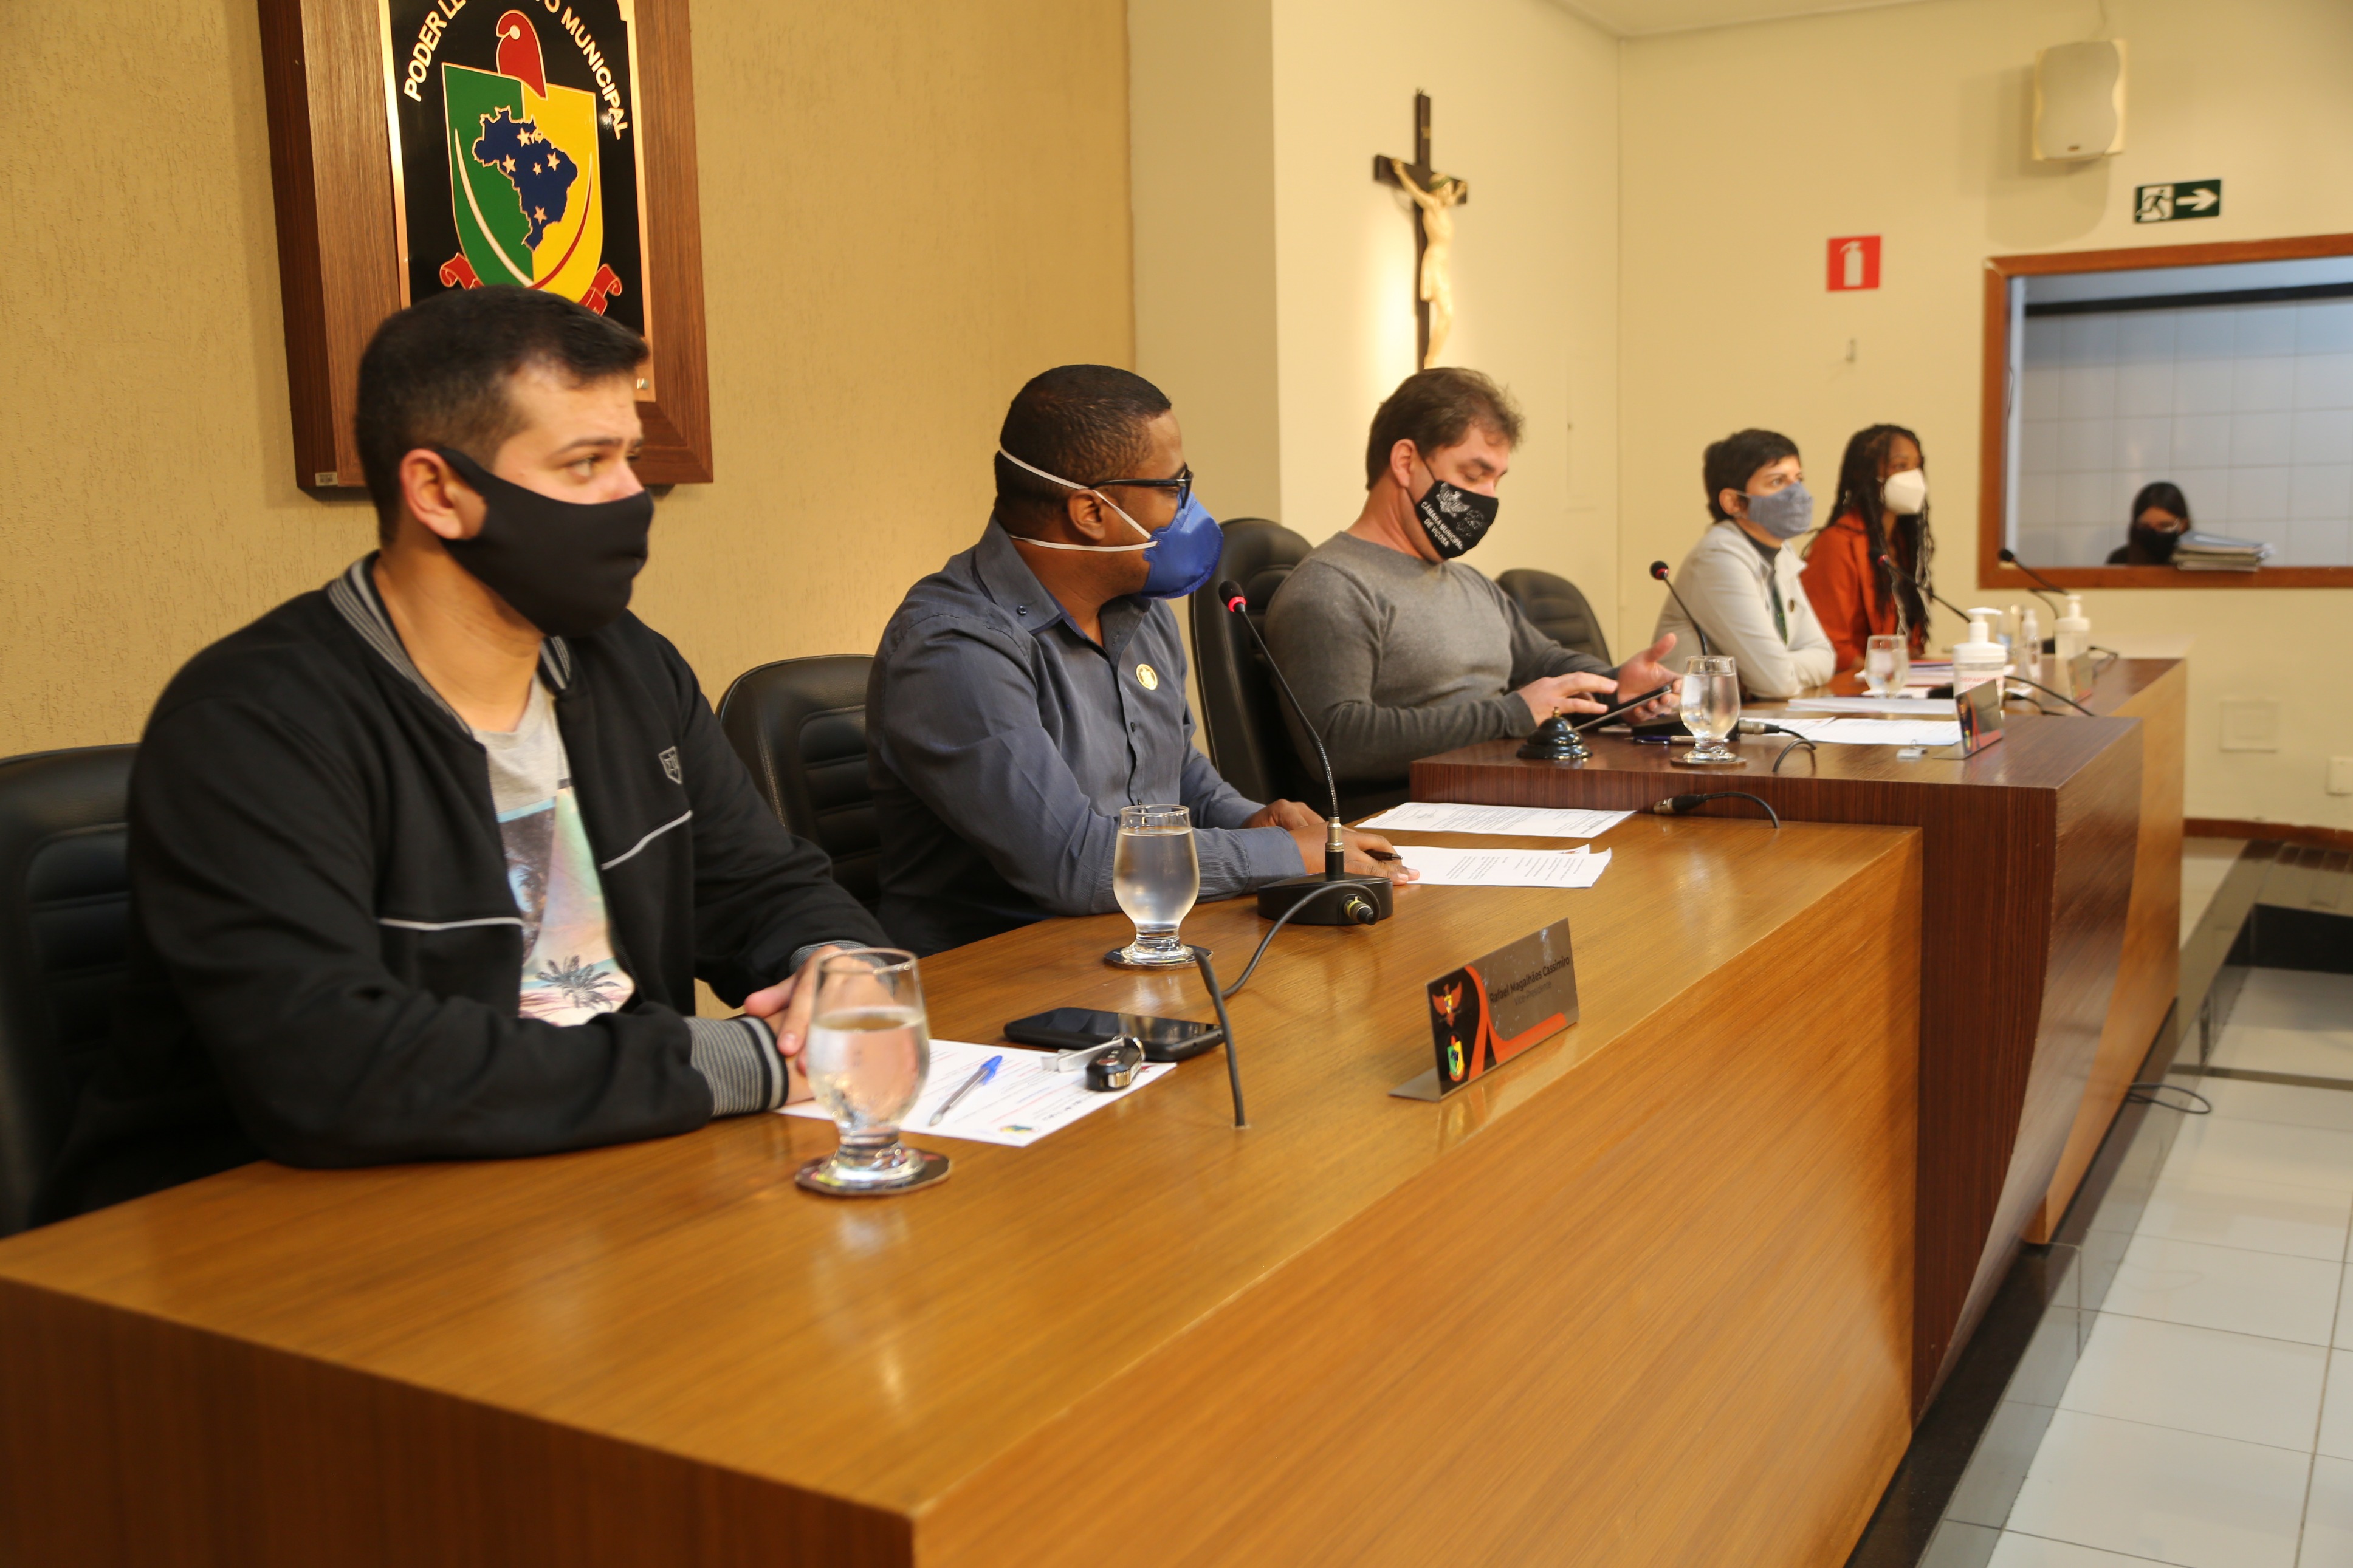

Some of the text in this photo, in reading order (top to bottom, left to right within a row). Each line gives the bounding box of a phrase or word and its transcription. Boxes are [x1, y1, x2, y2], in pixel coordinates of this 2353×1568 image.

[404, 6, 628, 140] PODER MUNICIPAL
[1424, 518, 1450, 547] DE VIÇOSA
[1439, 523, 1463, 550] MUNICIPAL
[1489, 984, 1510, 1004] Rafael
[1542, 956, 1570, 977] Cassimiro
